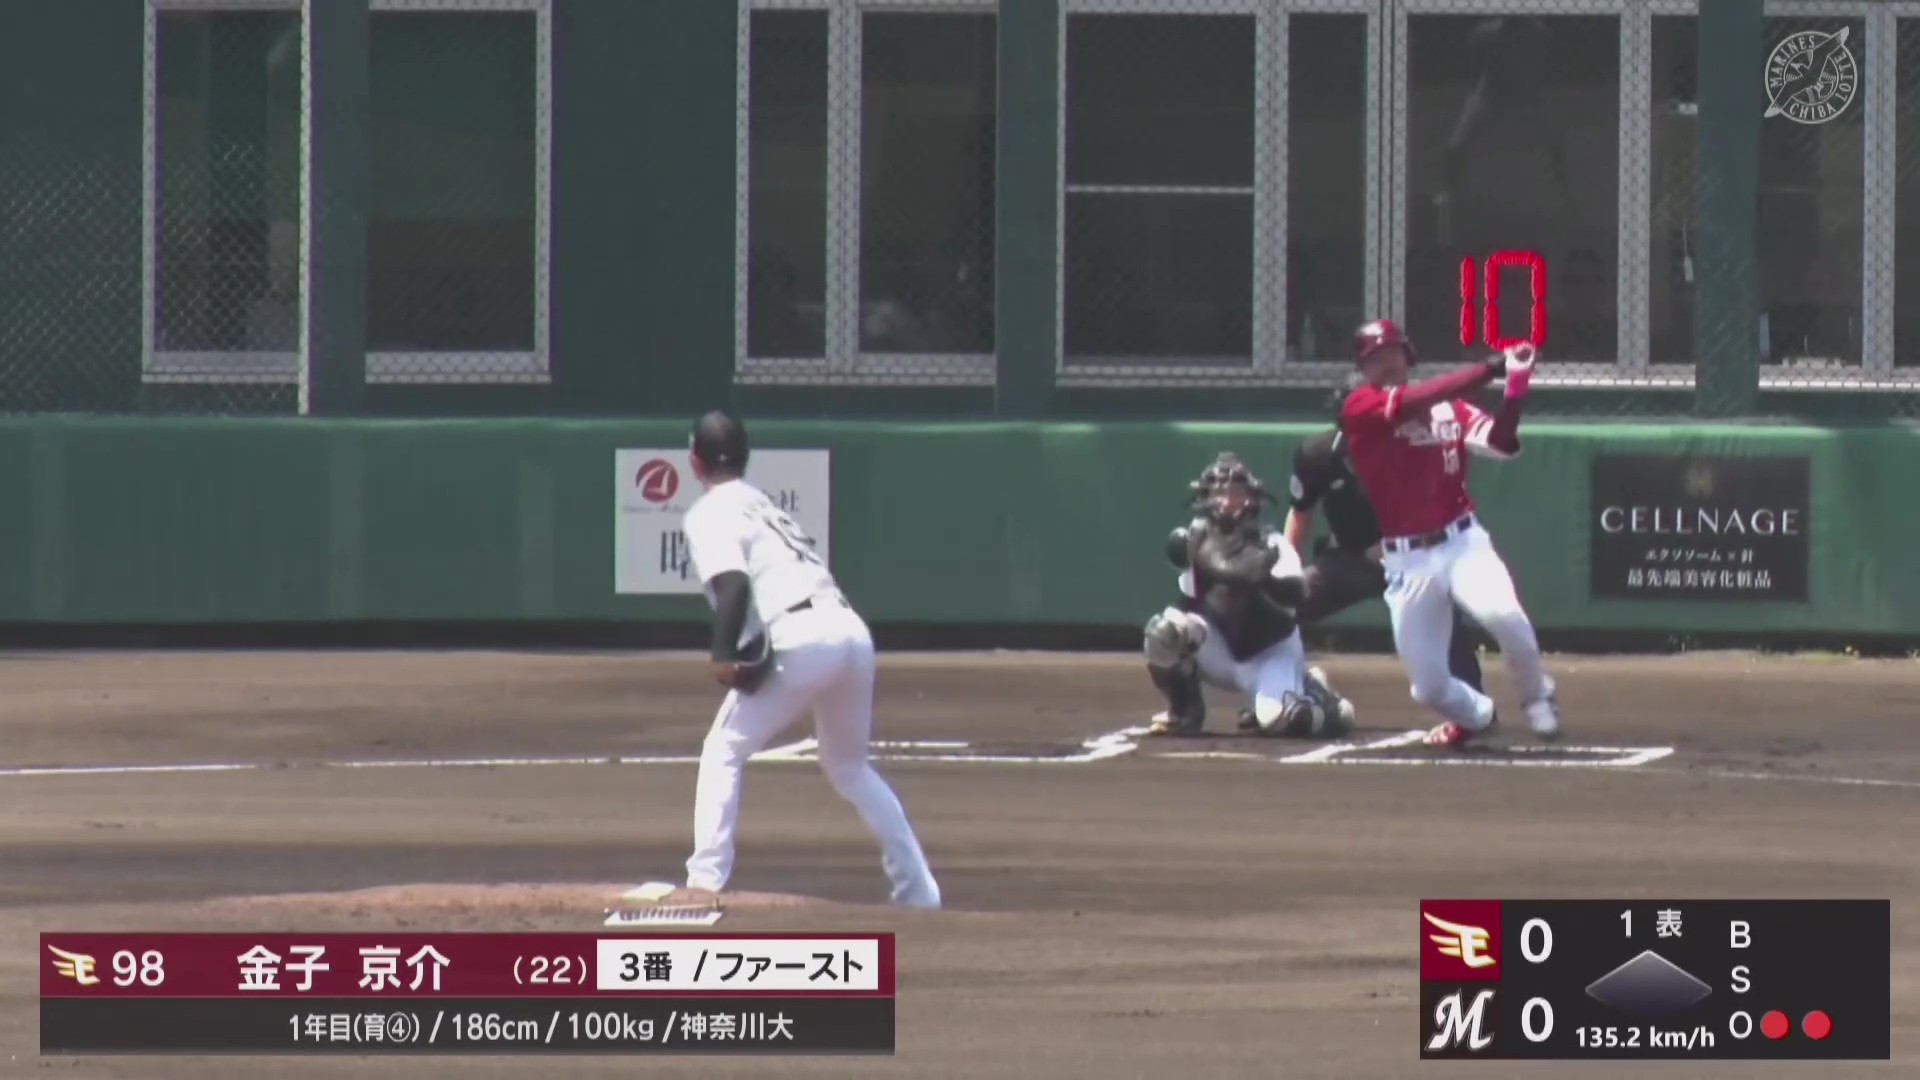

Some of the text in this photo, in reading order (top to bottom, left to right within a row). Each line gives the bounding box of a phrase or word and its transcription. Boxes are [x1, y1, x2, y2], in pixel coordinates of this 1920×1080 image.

[1459, 249, 1546, 353] 10
[1600, 506, 1799, 535] CELLNAGE
[1626, 567, 1772, 590] 最先端美容化粧品
